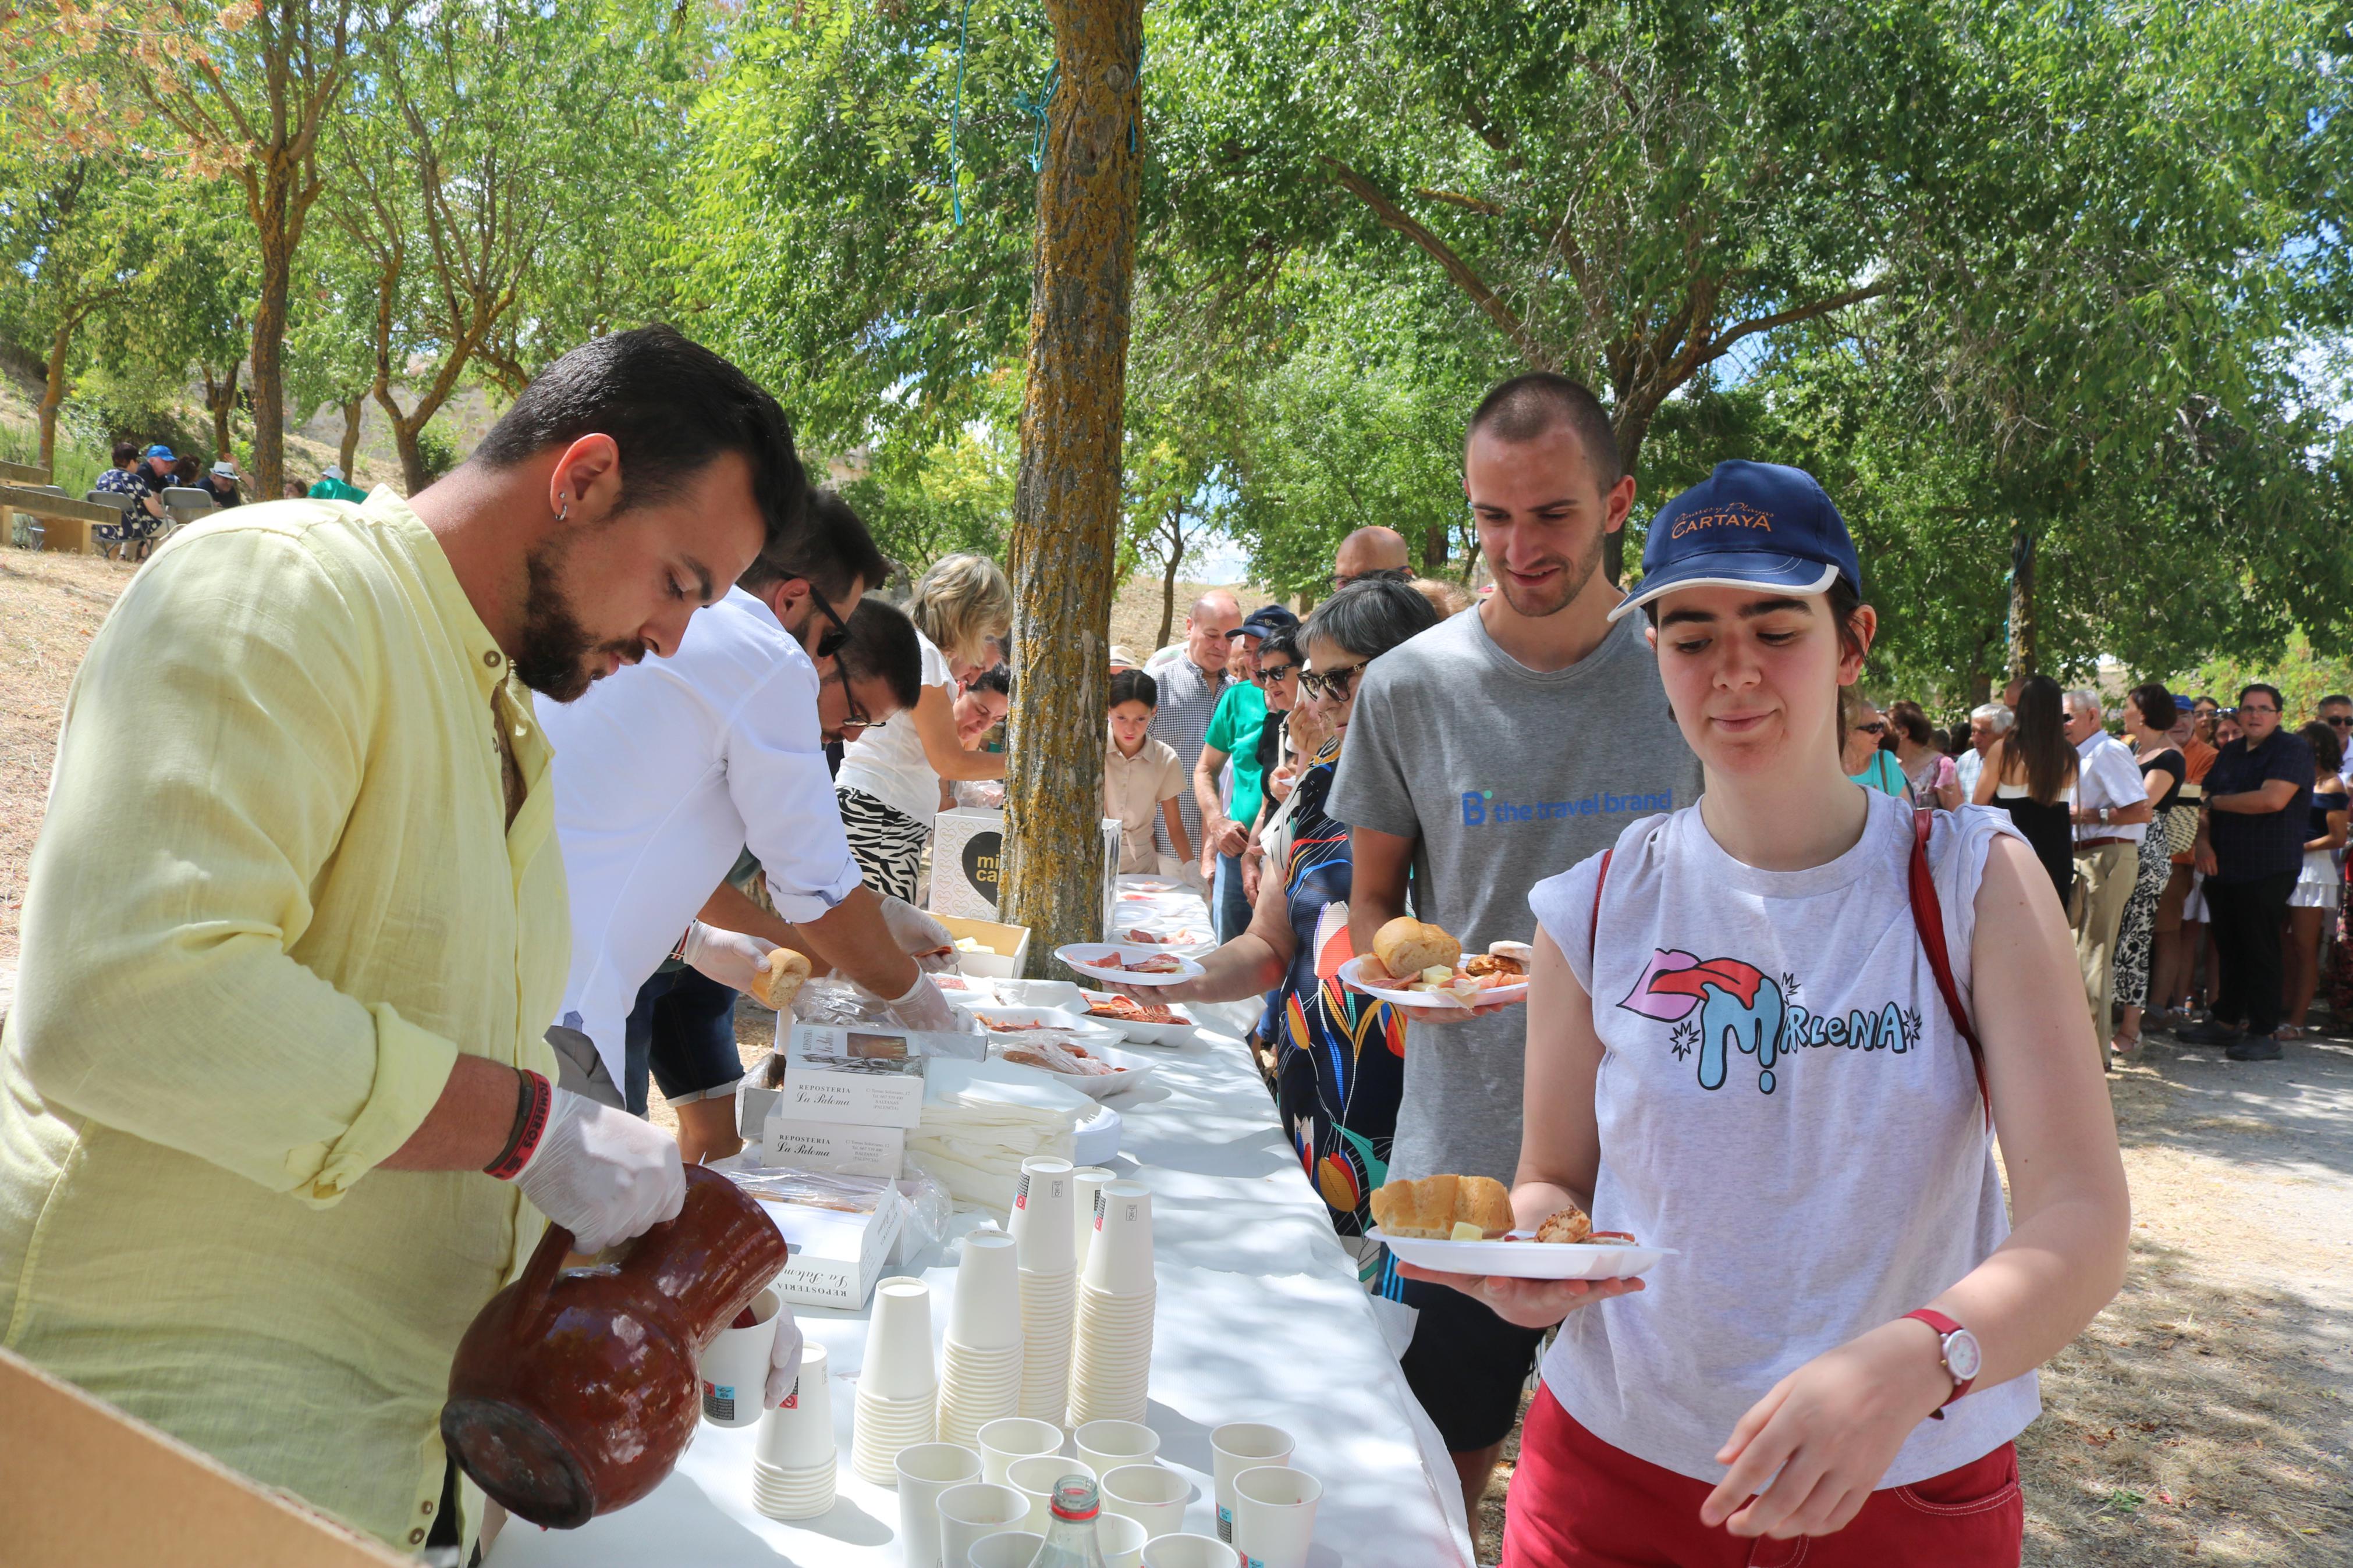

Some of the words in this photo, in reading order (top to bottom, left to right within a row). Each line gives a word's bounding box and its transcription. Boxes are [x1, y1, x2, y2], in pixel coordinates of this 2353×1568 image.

[1725, 502, 1774, 517] Playas
[1671, 514, 1772, 539] CARTAYA
[1493, 801, 1532, 823] the
[1536, 792, 1599, 821] travel
[1605, 788, 1672, 814] brand
[975, 870, 998, 883] ca
[798, 1084, 851, 1094] REPOSTERIA
[795, 1091, 810, 1103] La
[813, 1093, 851, 1106] Paloma
[779, 1135, 831, 1144] REPOSTERIA
[776, 1141, 792, 1153] La
[793, 1144, 830, 1157] Paloma
[780, 1268, 824, 1285] Palom
[828, 1274, 848, 1288] La
[777, 1282, 847, 1297] REPOSTERIA
